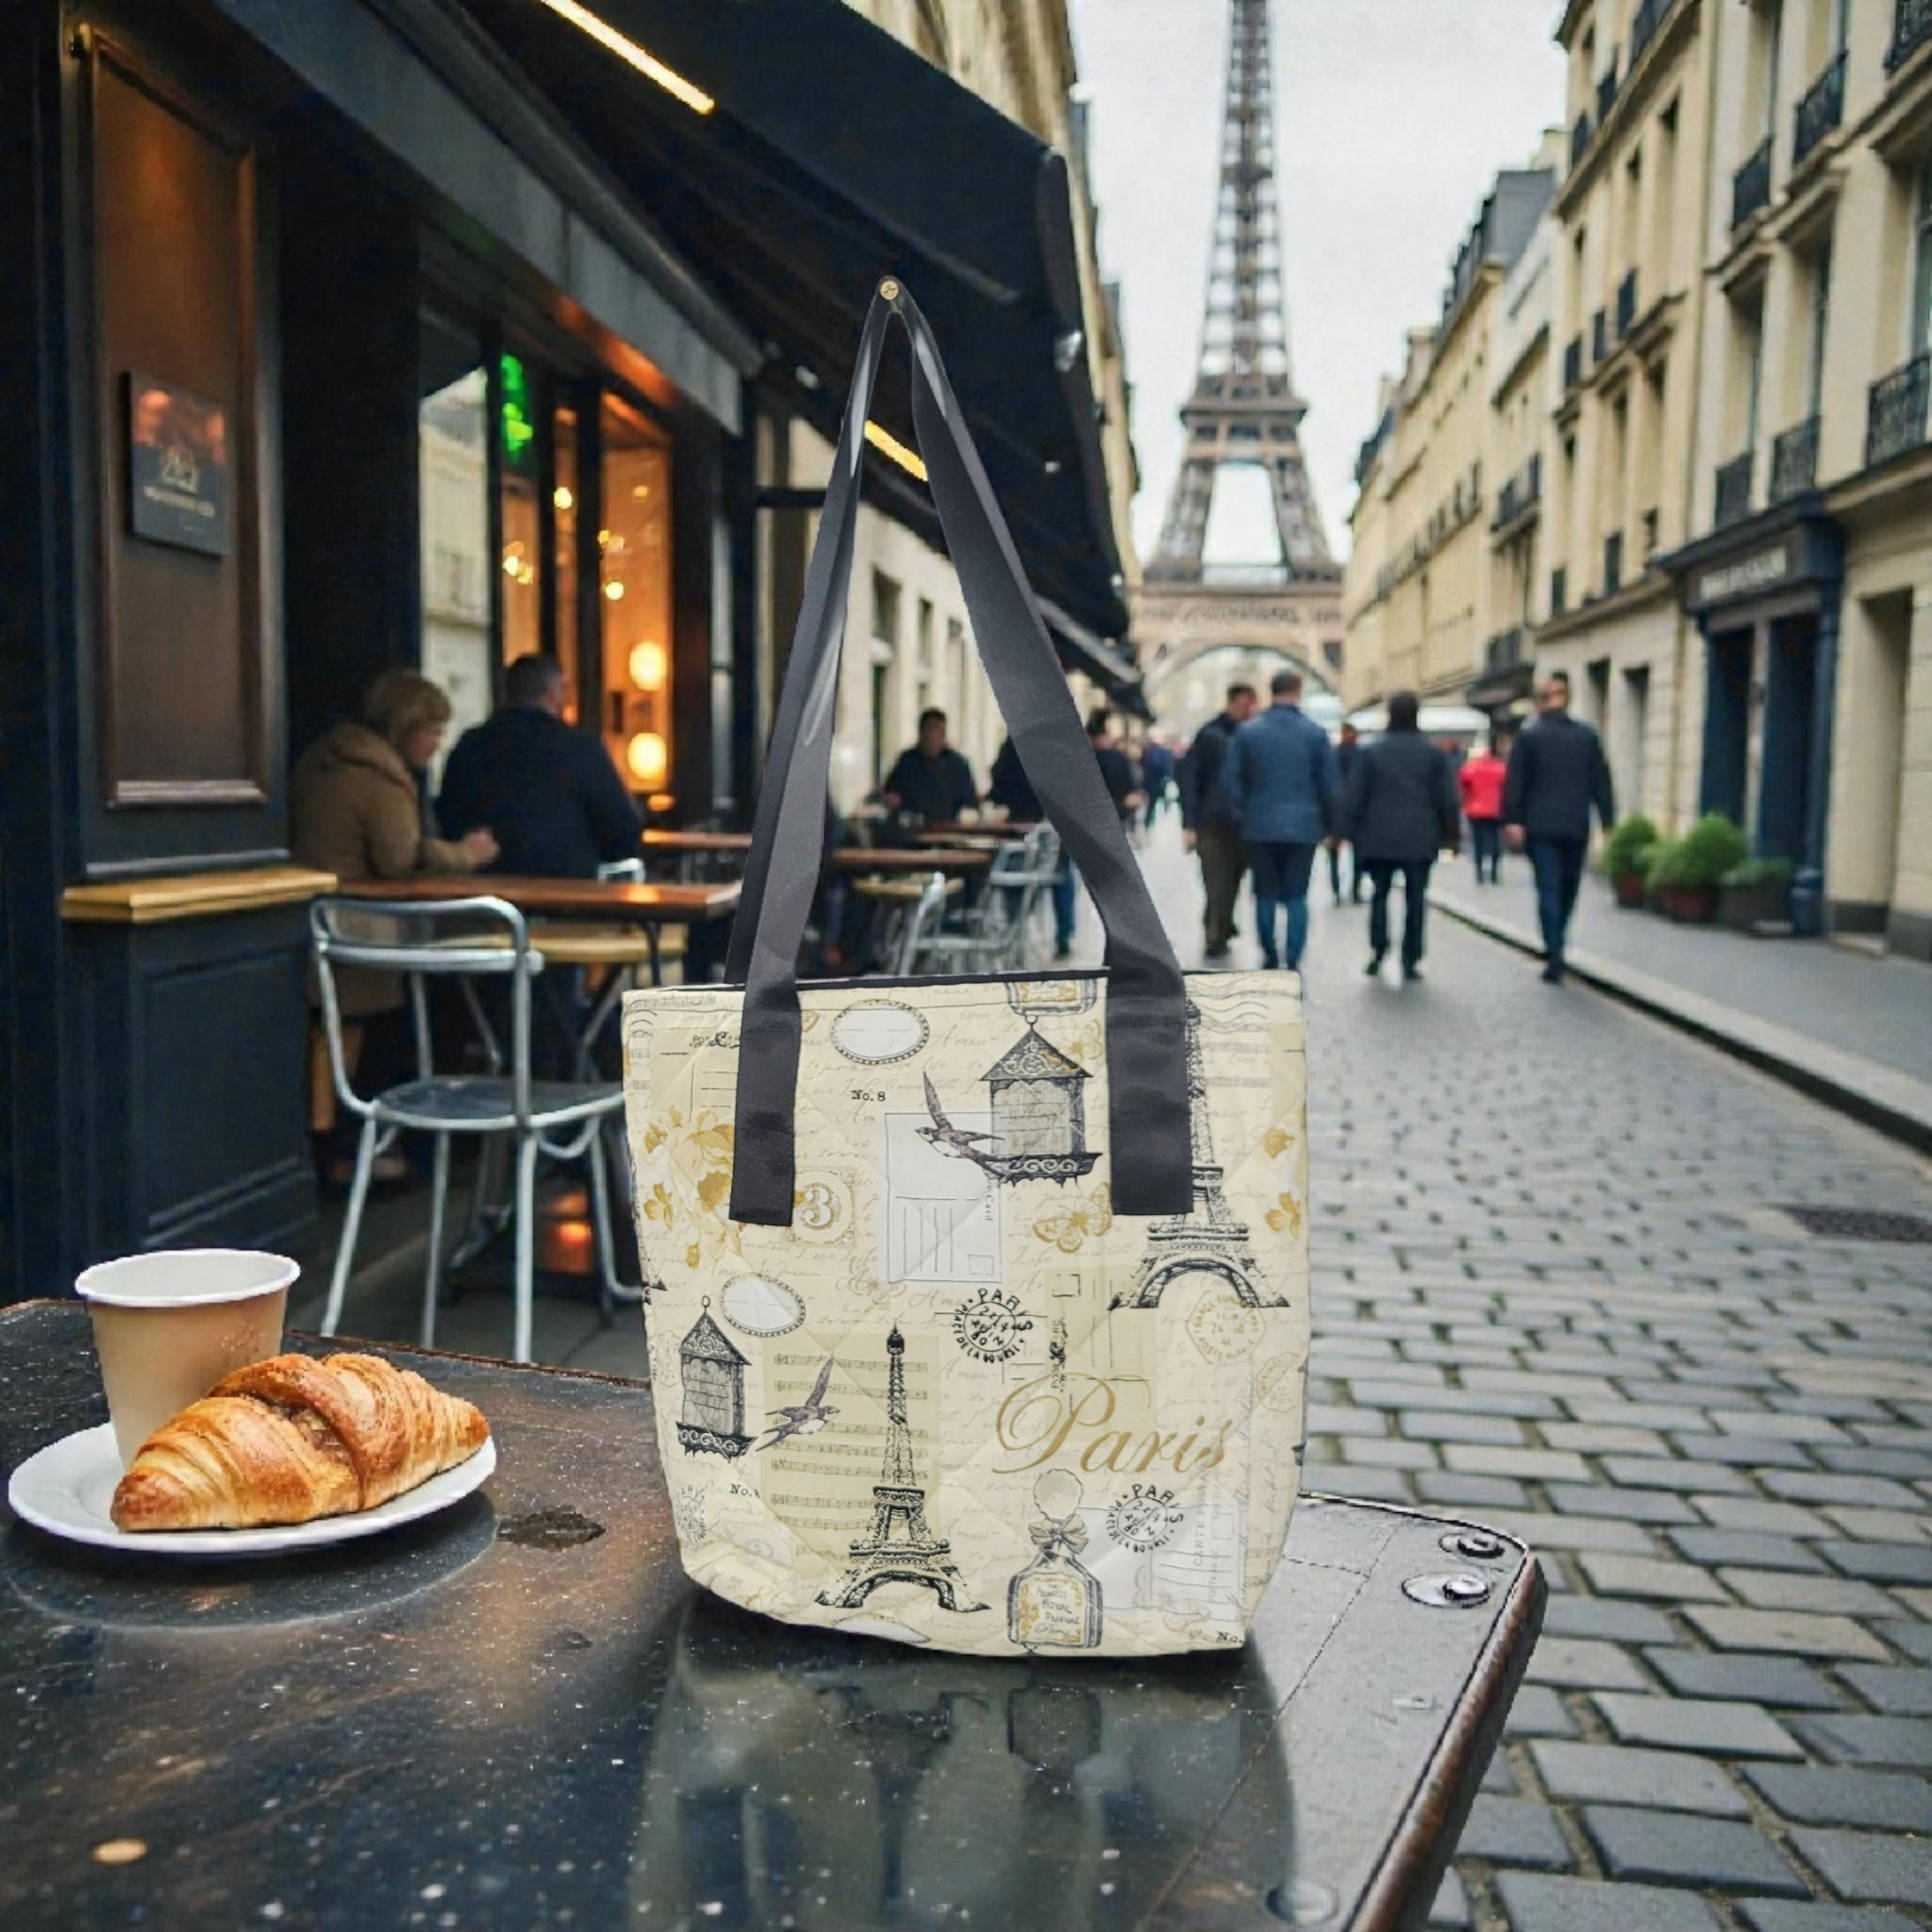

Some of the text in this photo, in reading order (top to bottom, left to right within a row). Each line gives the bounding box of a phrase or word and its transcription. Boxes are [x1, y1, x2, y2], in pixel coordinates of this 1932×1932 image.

[851, 1089, 886, 1102] No. 8
[803, 1186, 832, 1227] 3
[977, 1288, 1034, 1332] PARIS
[991, 1372, 1234, 1474] Paris
[729, 1483, 753, 1497] No.
[1132, 1484, 1185, 1524] PARIS
[1193, 1519, 1206, 1566] CARTE
[1216, 1630, 1244, 1644] No.
